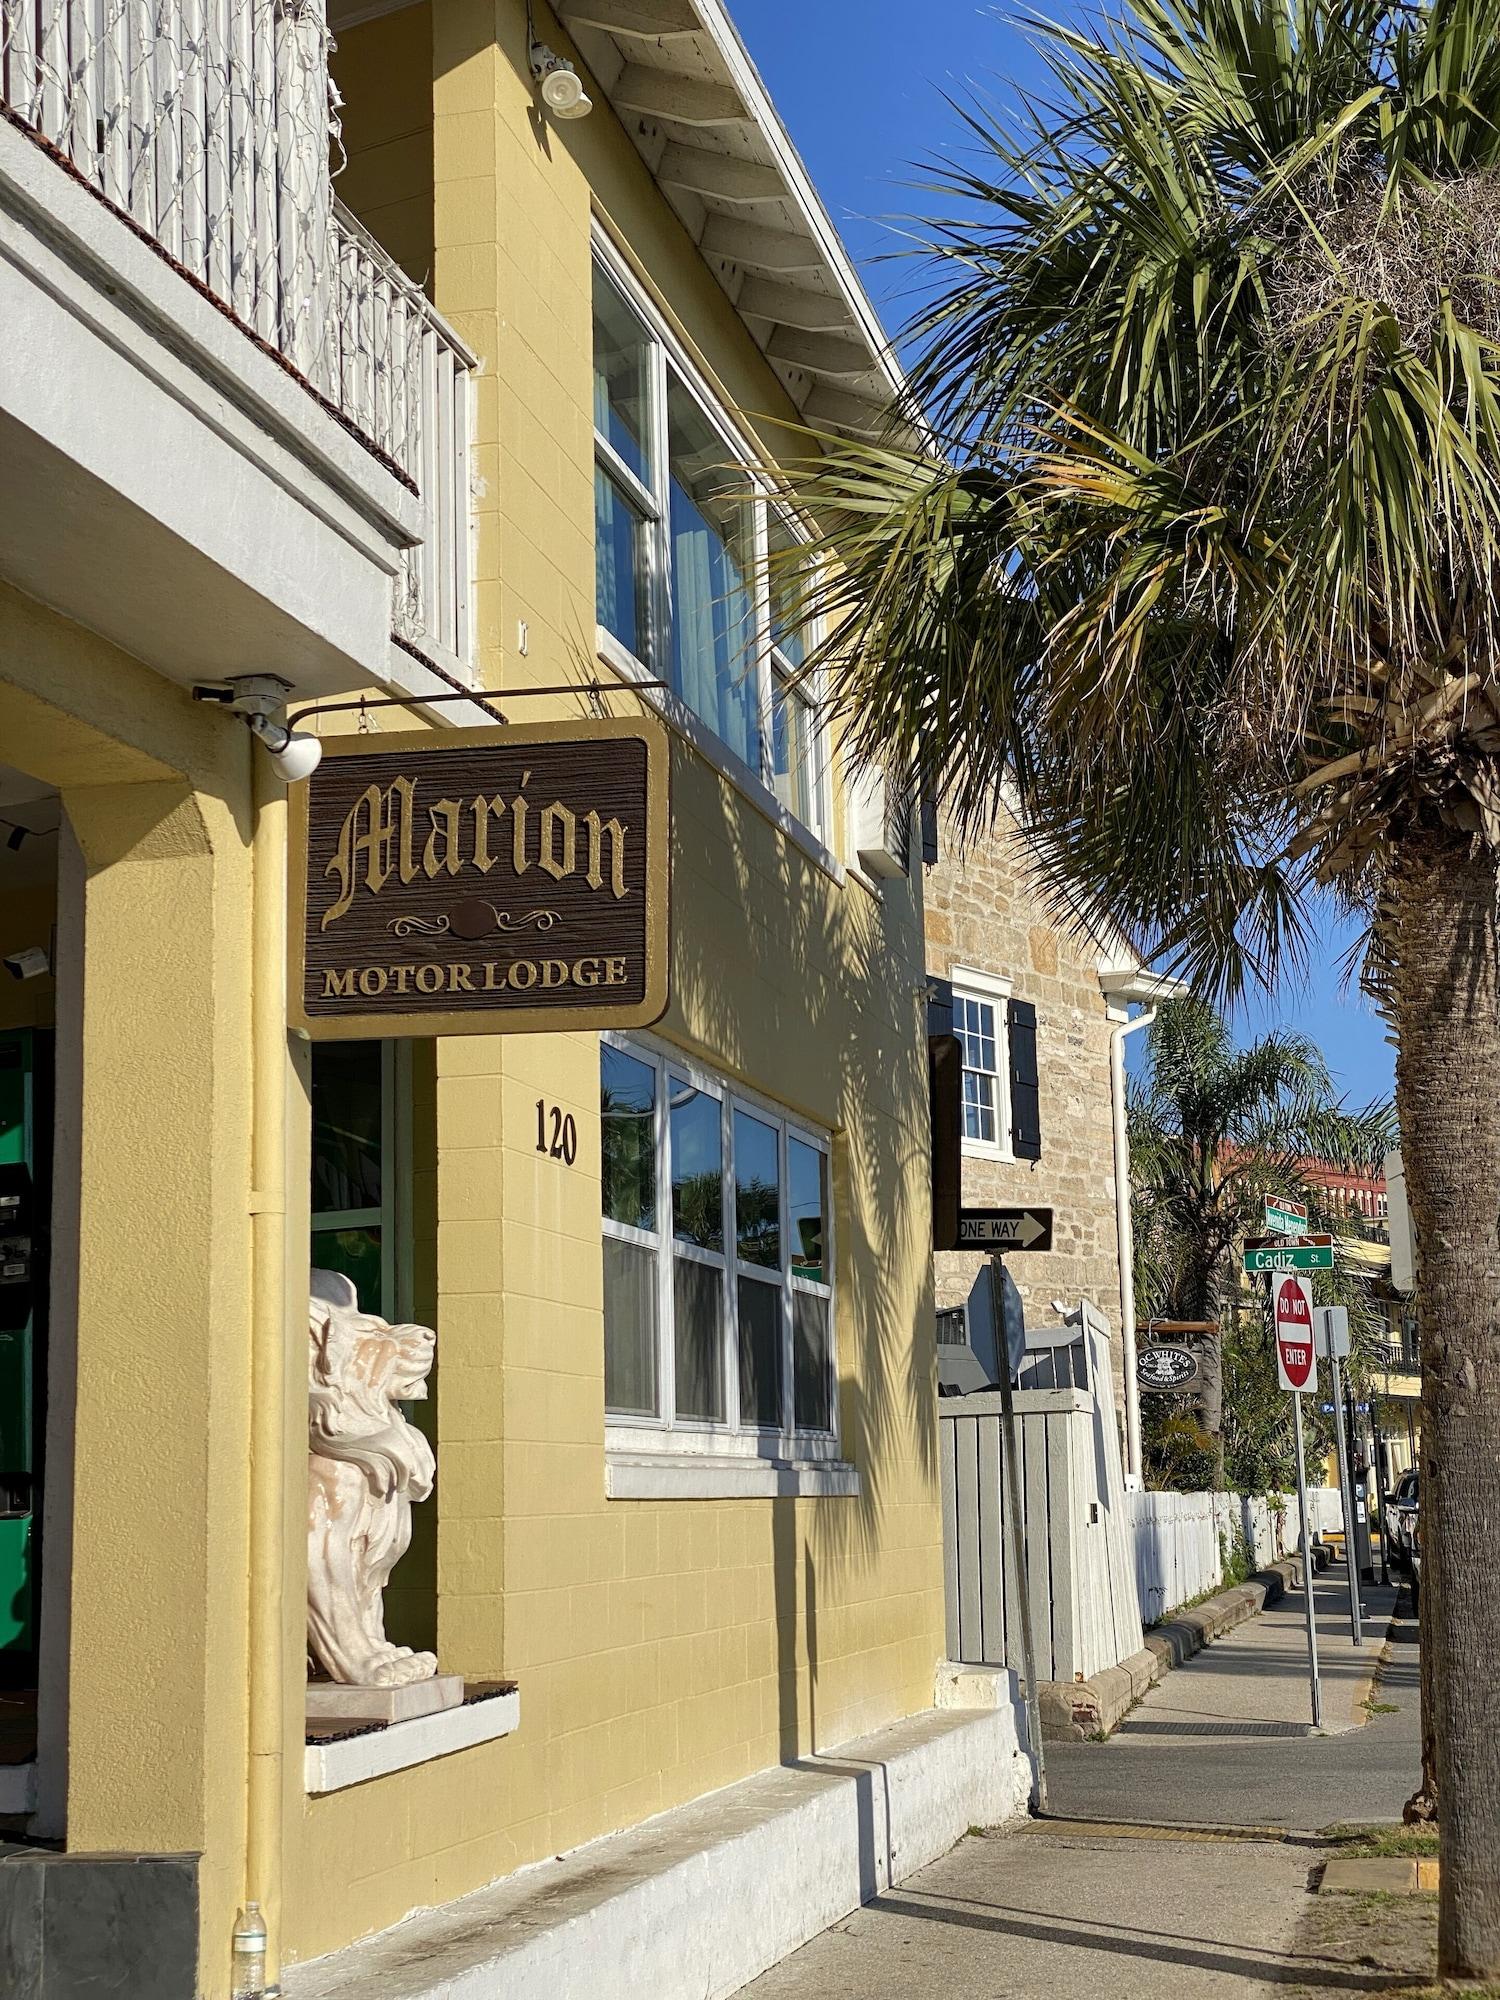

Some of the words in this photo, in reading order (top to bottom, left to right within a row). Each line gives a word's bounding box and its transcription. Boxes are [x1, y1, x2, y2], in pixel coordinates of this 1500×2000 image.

[321, 770, 629, 932] Marion
[320, 963, 476, 997] MOTOR
[481, 956, 628, 990] LODGE
[535, 1099, 577, 1166] 120
[960, 1221, 986, 1238] ONE
[991, 1221, 1020, 1238] WAY
[1273, 1239, 1285, 1248] OLD
[1286, 1237, 1300, 1247] TOWN
[1255, 1251, 1295, 1269] Cadiz
[1310, 1253, 1321, 1263] St.
[1279, 1297, 1290, 1314] DO
[1292, 1298, 1306, 1316] NOT
[1285, 1348, 1307, 1366] ENTER
[1140, 1368, 1163, 1382] Seafood
[1169, 1370, 1189, 1383] Spirits
